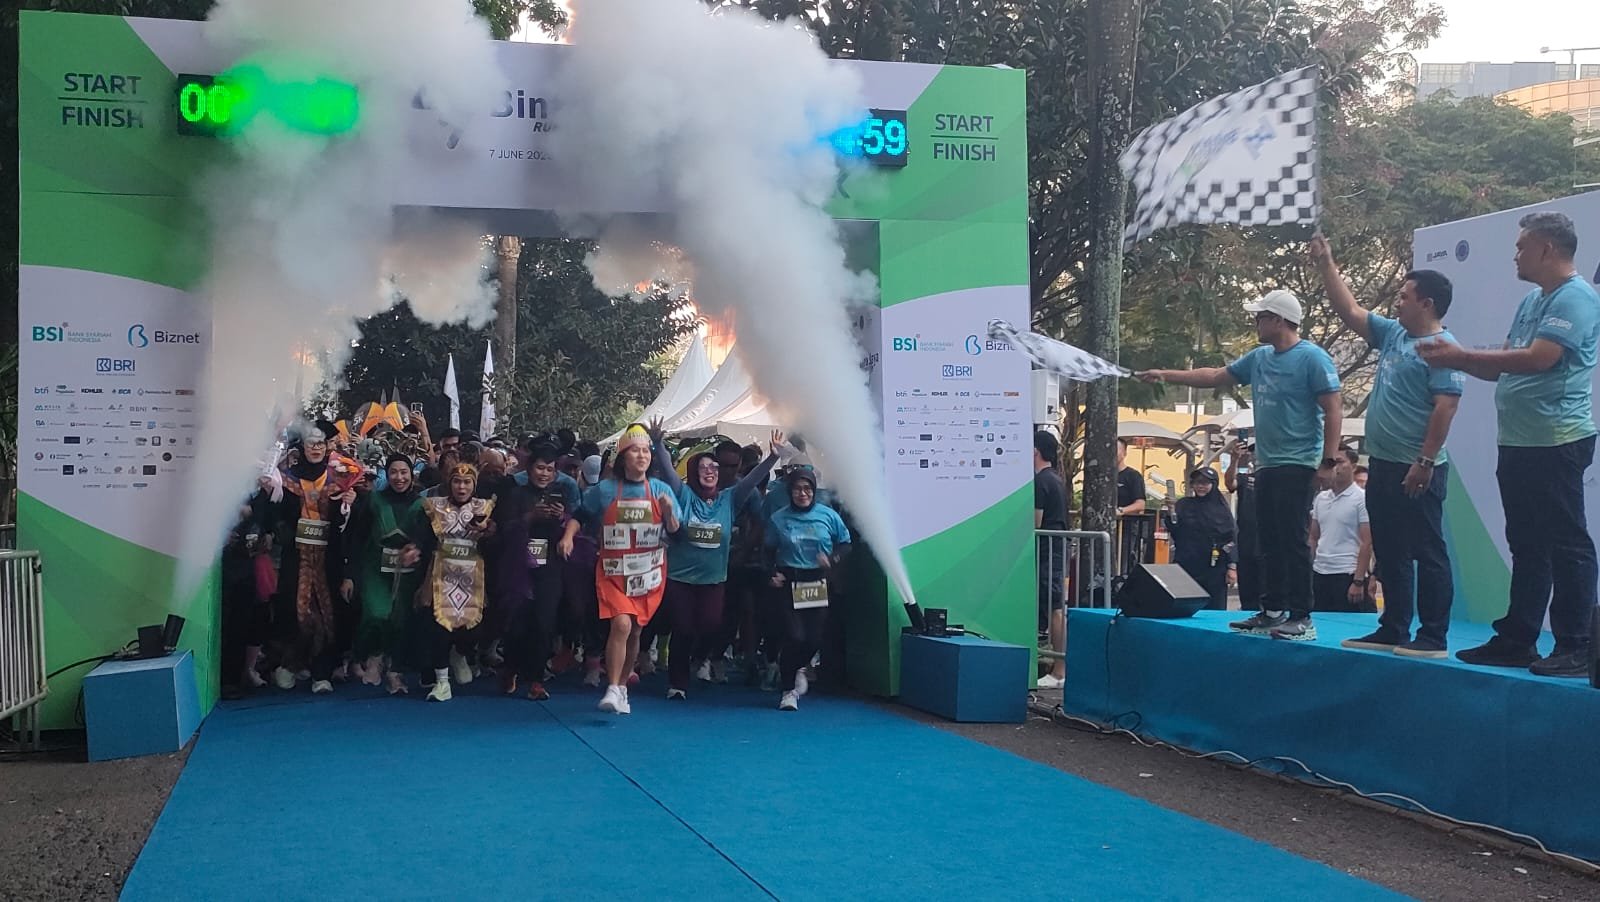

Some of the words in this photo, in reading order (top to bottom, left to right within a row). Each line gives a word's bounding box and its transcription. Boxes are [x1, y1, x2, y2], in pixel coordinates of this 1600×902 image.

[63, 72, 142, 96] START
[61, 105, 144, 129] FINISH
[935, 113, 994, 133] START
[489, 149, 496, 159] 7
[497, 149, 525, 160] JUNE
[933, 142, 996, 162] FINISH
[32, 326, 63, 342] BSI
[154, 331, 201, 344] Biznet
[893, 337, 917, 352] BSI
[113, 359, 136, 372] BRI
[955, 365, 973, 376] BRI
[623, 509, 645, 521] 5420
[695, 530, 714, 540] 5128
[801, 587, 819, 600] 5174
